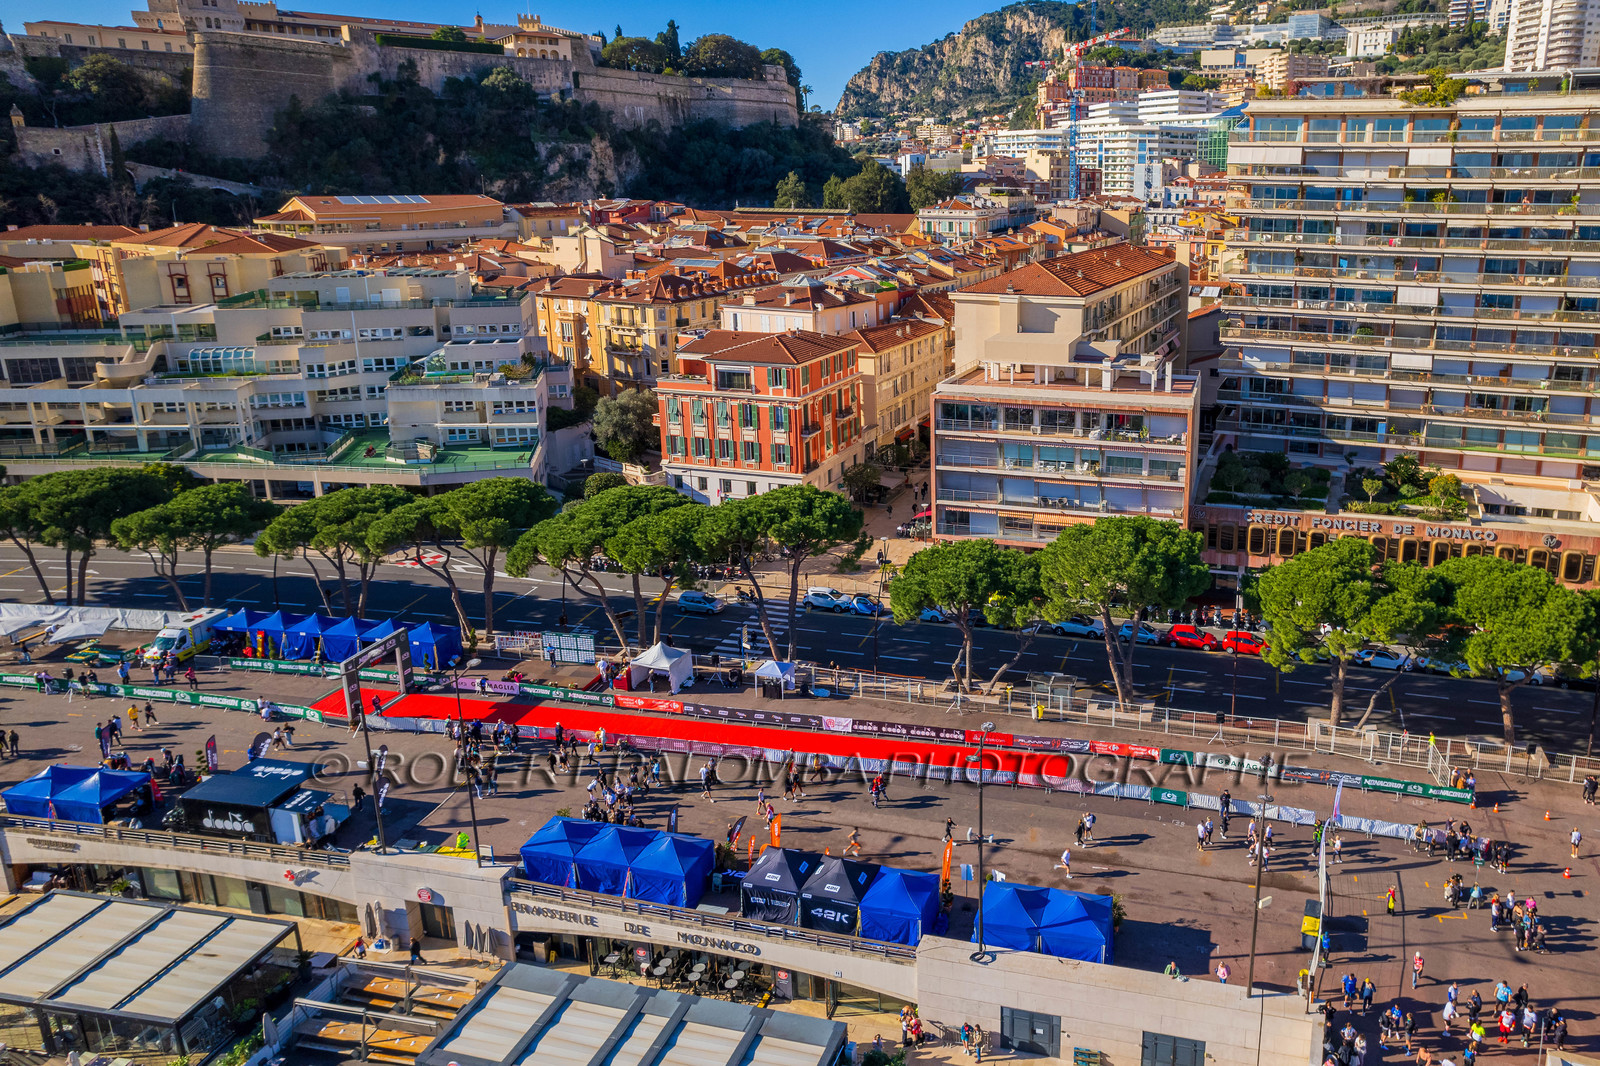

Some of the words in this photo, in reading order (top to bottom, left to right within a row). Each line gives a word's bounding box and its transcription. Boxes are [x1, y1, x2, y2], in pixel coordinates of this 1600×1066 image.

[1245, 512, 1299, 526] CREDIT
[1312, 517, 1381, 532] FONCIER
[1393, 523, 1414, 535] DE
[1426, 526, 1497, 541] MONACO
[471, 682, 515, 692] GRMAGLIA
[1364, 778, 1405, 790] MONACORUN
[1428, 788, 1472, 800] MONACORUN
[203, 809, 254, 832] diadora
[811, 907, 850, 924] 42K
[511, 901, 593, 926] BRASSERIE
[624, 922, 646, 935] DE
[677, 931, 757, 954] MONACO
